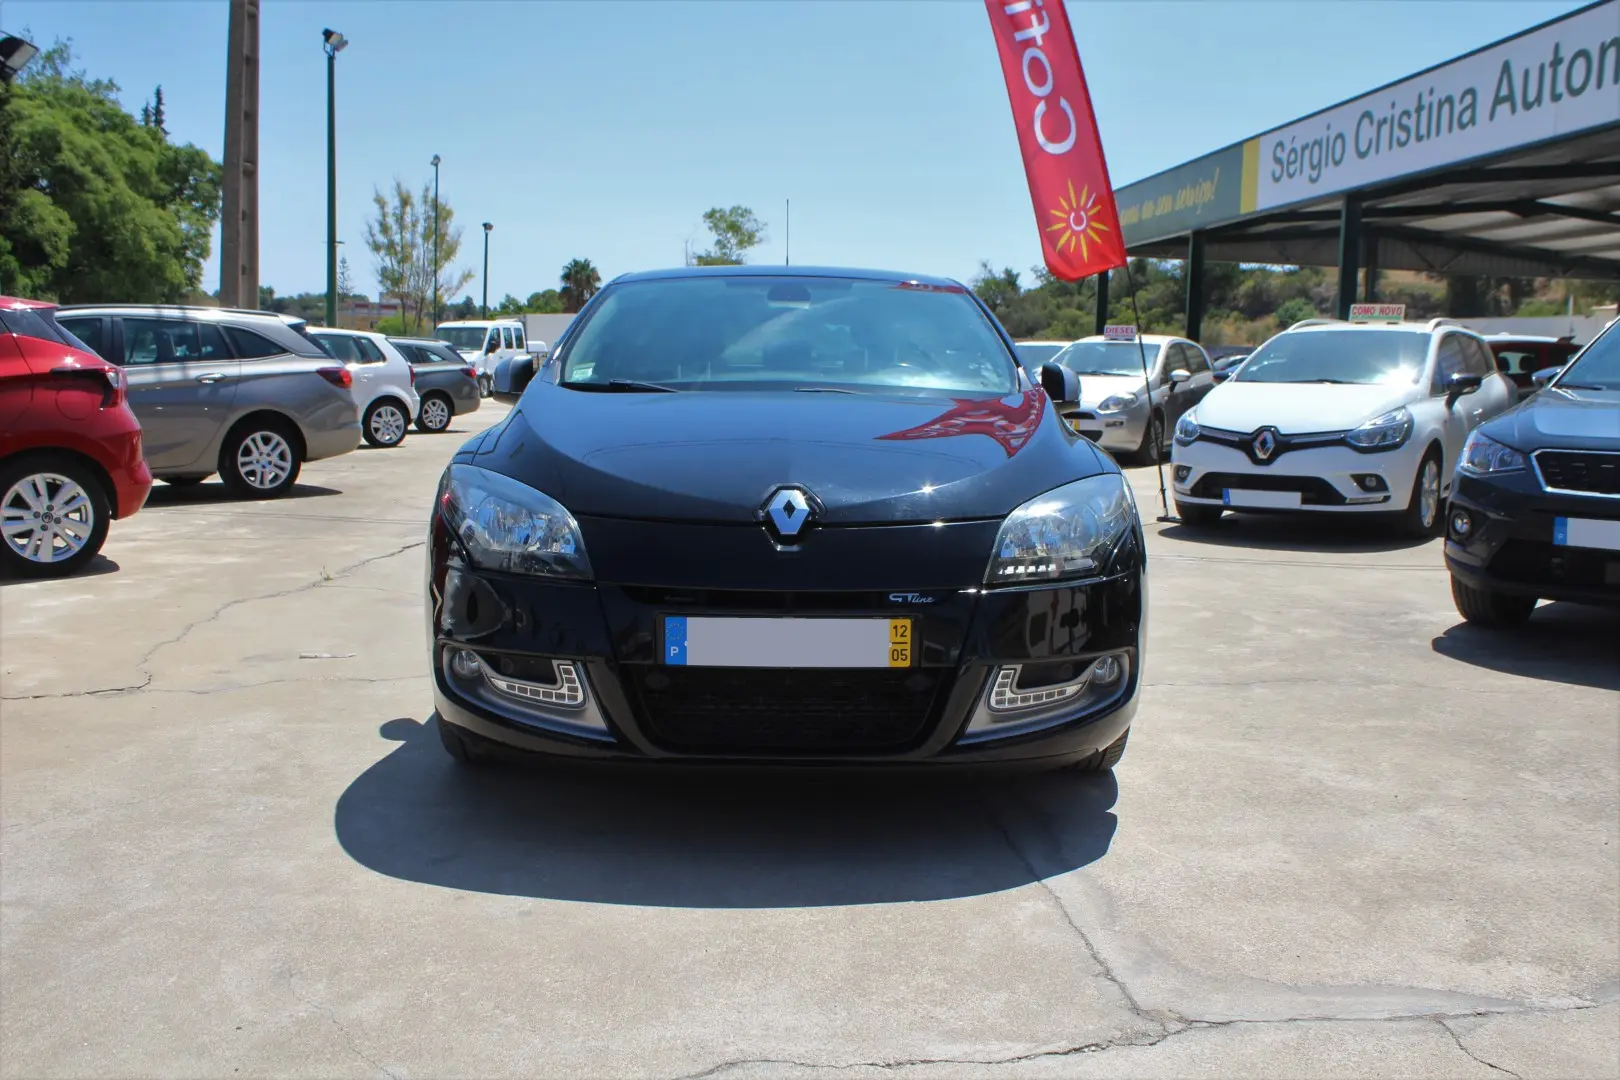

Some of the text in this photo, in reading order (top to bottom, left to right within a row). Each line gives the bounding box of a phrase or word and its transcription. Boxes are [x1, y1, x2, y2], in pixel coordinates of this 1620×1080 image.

[1271, 124, 1347, 185] Sérgio
[1354, 85, 1478, 160] Cristina
[1351, 305, 1402, 316] COMO NOVO
[1105, 326, 1135, 334] DIESEL
[892, 624, 908, 638] 12
[670, 645, 679, 657] P
[891, 648, 908, 662] 05
